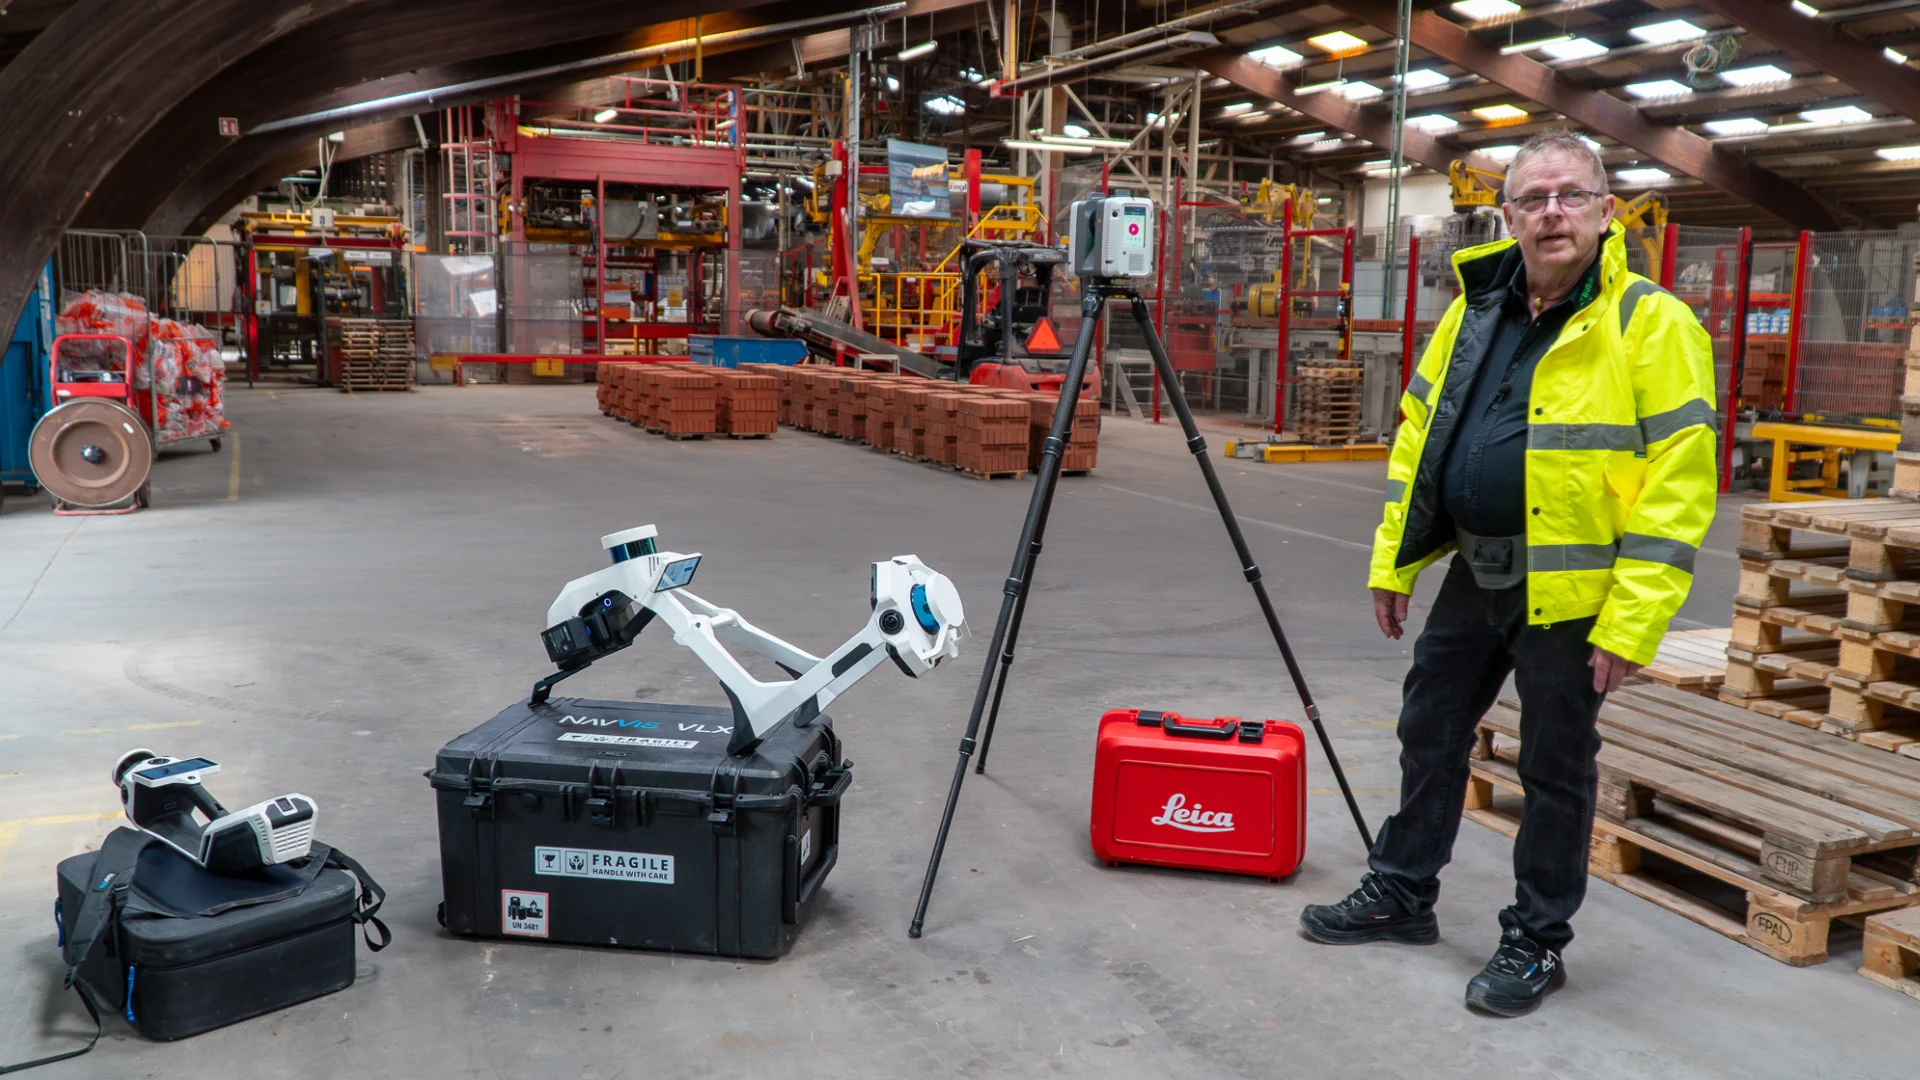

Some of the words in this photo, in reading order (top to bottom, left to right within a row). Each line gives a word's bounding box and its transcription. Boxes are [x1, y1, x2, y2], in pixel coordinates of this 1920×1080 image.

[678, 722, 735, 734] VLX
[1151, 793, 1235, 832] Leica
[592, 854, 668, 871] FRAGILE
[1775, 855, 1799, 877] EUR
[592, 868, 624, 877] HANDLE
[625, 870, 647, 879] WITH
[648, 872, 668, 880] CARE
[512, 921, 522, 929] UN
[523, 922, 539, 930] 3481
